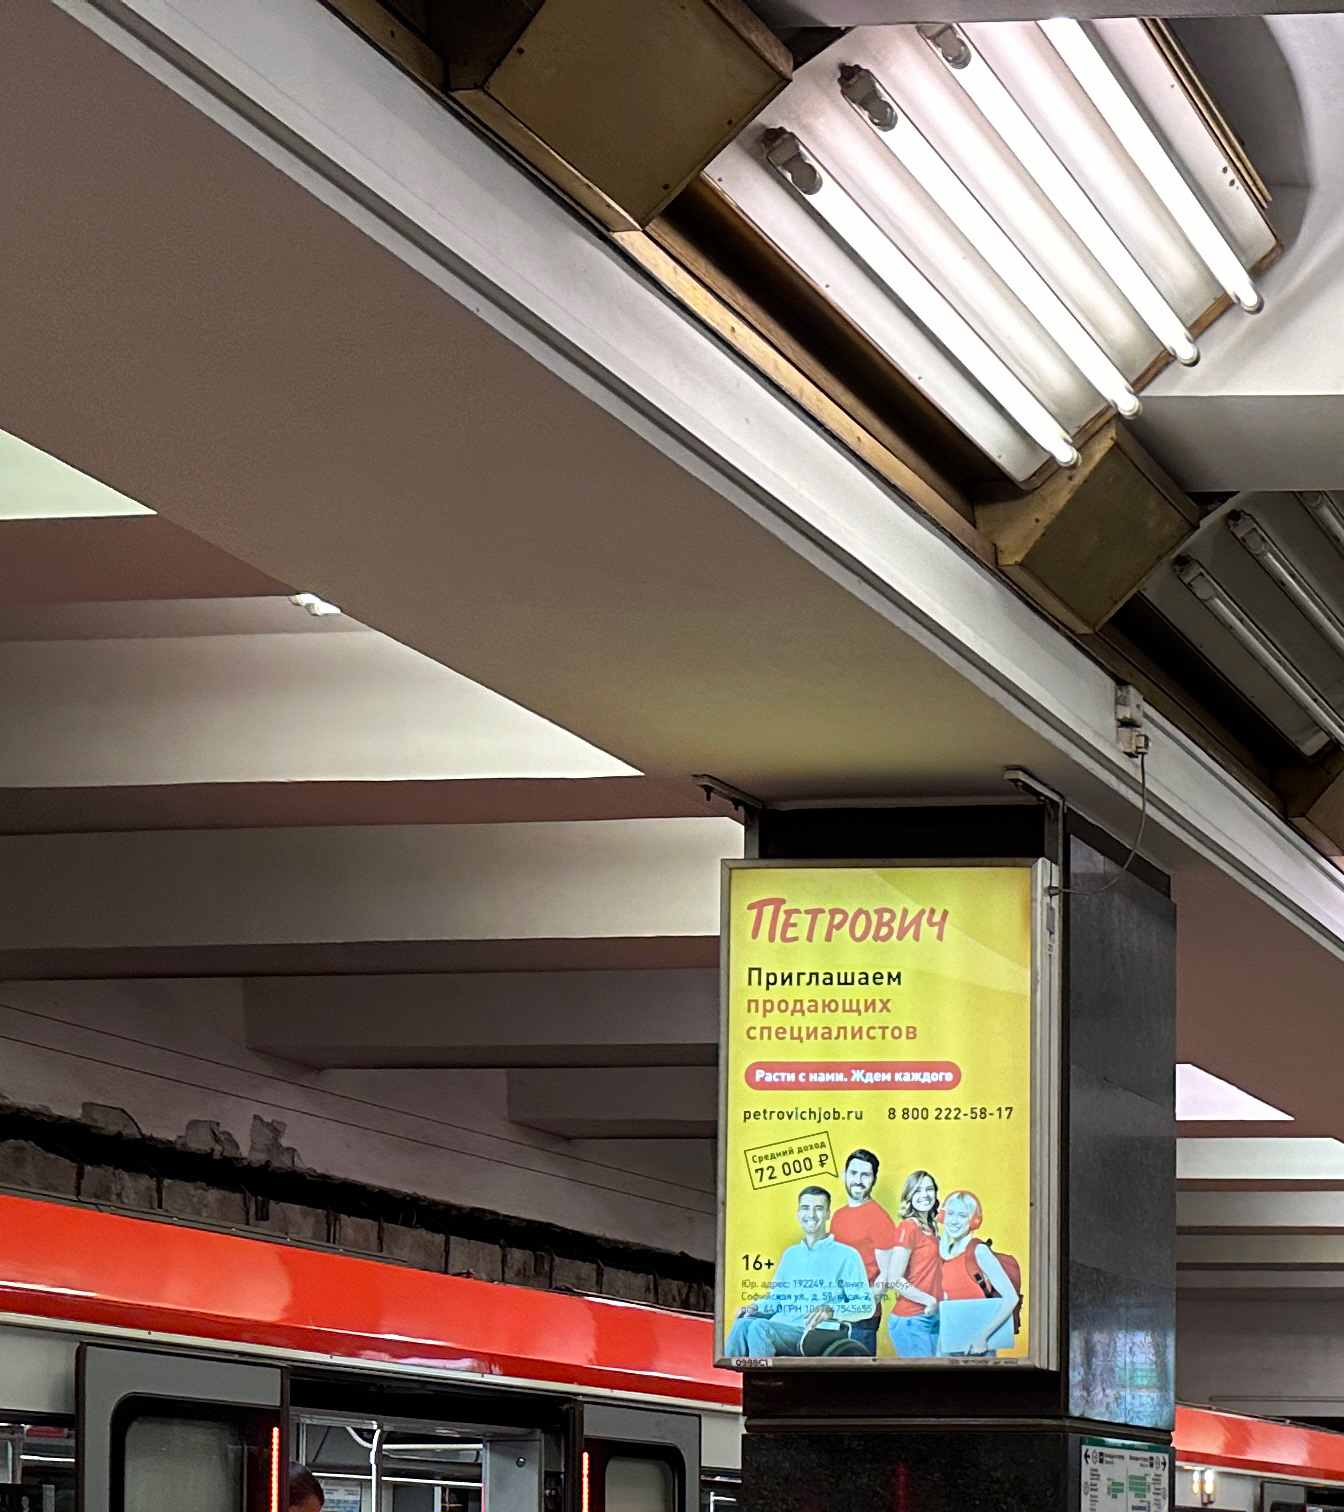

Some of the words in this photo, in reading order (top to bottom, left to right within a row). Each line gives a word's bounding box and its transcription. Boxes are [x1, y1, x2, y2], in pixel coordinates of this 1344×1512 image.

[746, 897, 950, 943] ПЕТРОВИЧ
[747, 967, 902, 990] Приглашаем
[746, 998, 892, 1018] продающих
[746, 1025, 918, 1043] специалистов
[755, 1069, 796, 1082] Расти
[799, 1072, 805, 1082] с
[808, 1072, 848, 1082] нами.
[850, 1069, 891, 1083] Ждем
[894, 1071, 954, 1083] каждого
[743, 1107, 863, 1123] petrovichjob.ru
[888, 1107, 896, 1120] 8
[901, 1107, 929, 1120] 800
[934, 1106, 1014, 1120] 222-58-17
[751, 1147, 795, 1164] Средний
[797, 1141, 827, 1154] доход
[755, 1164, 777, 1183] 72
[782, 1157, 813, 1177] 000
[741, 1254, 775, 1271] 16+
